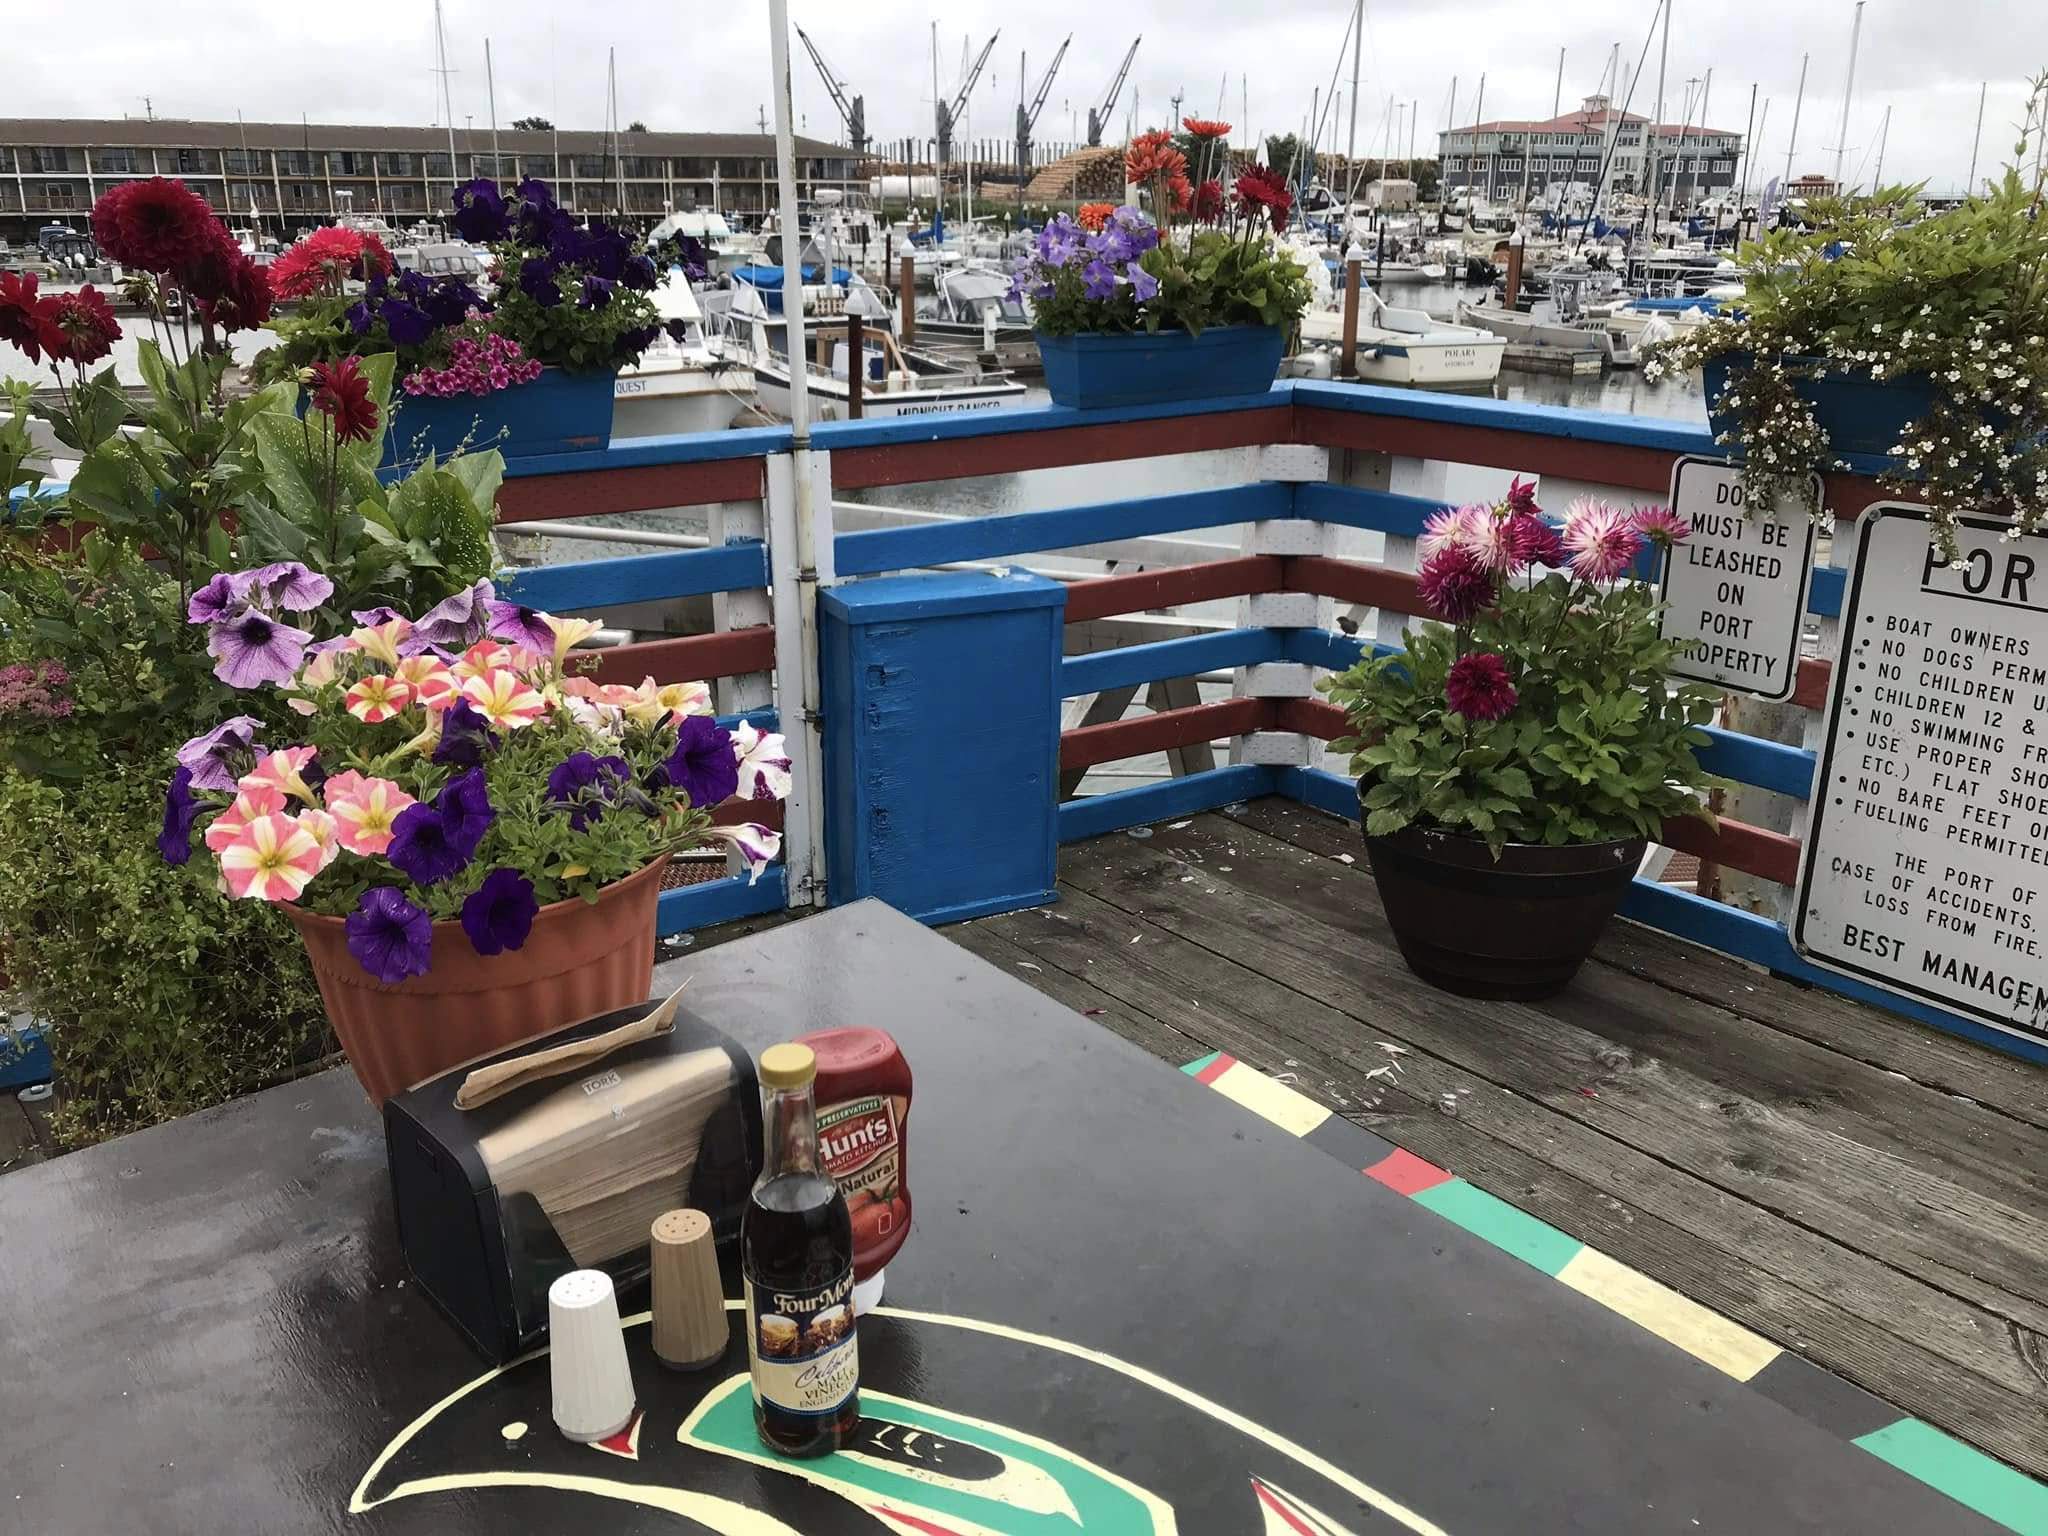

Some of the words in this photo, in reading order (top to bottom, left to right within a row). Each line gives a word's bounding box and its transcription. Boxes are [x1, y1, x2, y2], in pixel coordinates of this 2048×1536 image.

[615, 380, 647, 394] QUEST
[1716, 482, 1769, 510] DOS
[1691, 512, 1745, 540] MUST
[1761, 522, 1790, 547] BE
[1689, 546, 1782, 580] LEASHED
[1717, 582, 1745, 606] ON
[1699, 611, 1754, 640] PORT
[1886, 615, 1933, 638] BOAT
[1950, 627, 2030, 656] OWNERS
[1882, 639, 1906, 657] NO
[1923, 647, 1974, 671] DOGS
[1878, 663, 1902, 681] NO
[1919, 671, 2014, 705] CHILDREN
[2033, 694, 2048, 714] U
[1874, 686, 1966, 720] CHILDREN
[1984, 710, 2003, 728] 12
[2022, 719, 2036, 736] &
[1870, 709, 1893, 728] NO
[1910, 719, 2005, 754] SWIMMING
[1866, 731, 1899, 753] USE
[1917, 744, 1992, 776] PROPER
[1862, 755, 1911, 782] ETC.)
[1932, 772, 1980, 797] FLAT
[1854, 799, 1930, 832] FUELING
[1858, 776, 1881, 796] NO
[1897, 787, 1946, 813] BARE
[1962, 804, 2012, 830] FEET
[1831, 857, 1876, 882] CASE
[1891, 875, 1915, 893] OF
[1926, 886, 2037, 933] ACCIDENTS.
[1895, 852, 1928, 875] THE
[1944, 867, 1994, 894] PORT
[2012, 887, 2038, 906] OF
[1843, 923, 1906, 962] BEST
[1864, 890, 1910, 916] LOSS
[1926, 909, 1977, 937] FROM
[1993, 930, 2043, 960] FIRE.
[584, 1072, 618, 1092] TORK
[822, 1099, 879, 1127] PRESERVATIVES
[819, 1117, 888, 1161] Hunt's
[855, 1136, 888, 1158] KETCHUP
[840, 1158, 896, 1195] Natural
[772, 1294, 819, 1315] Four
